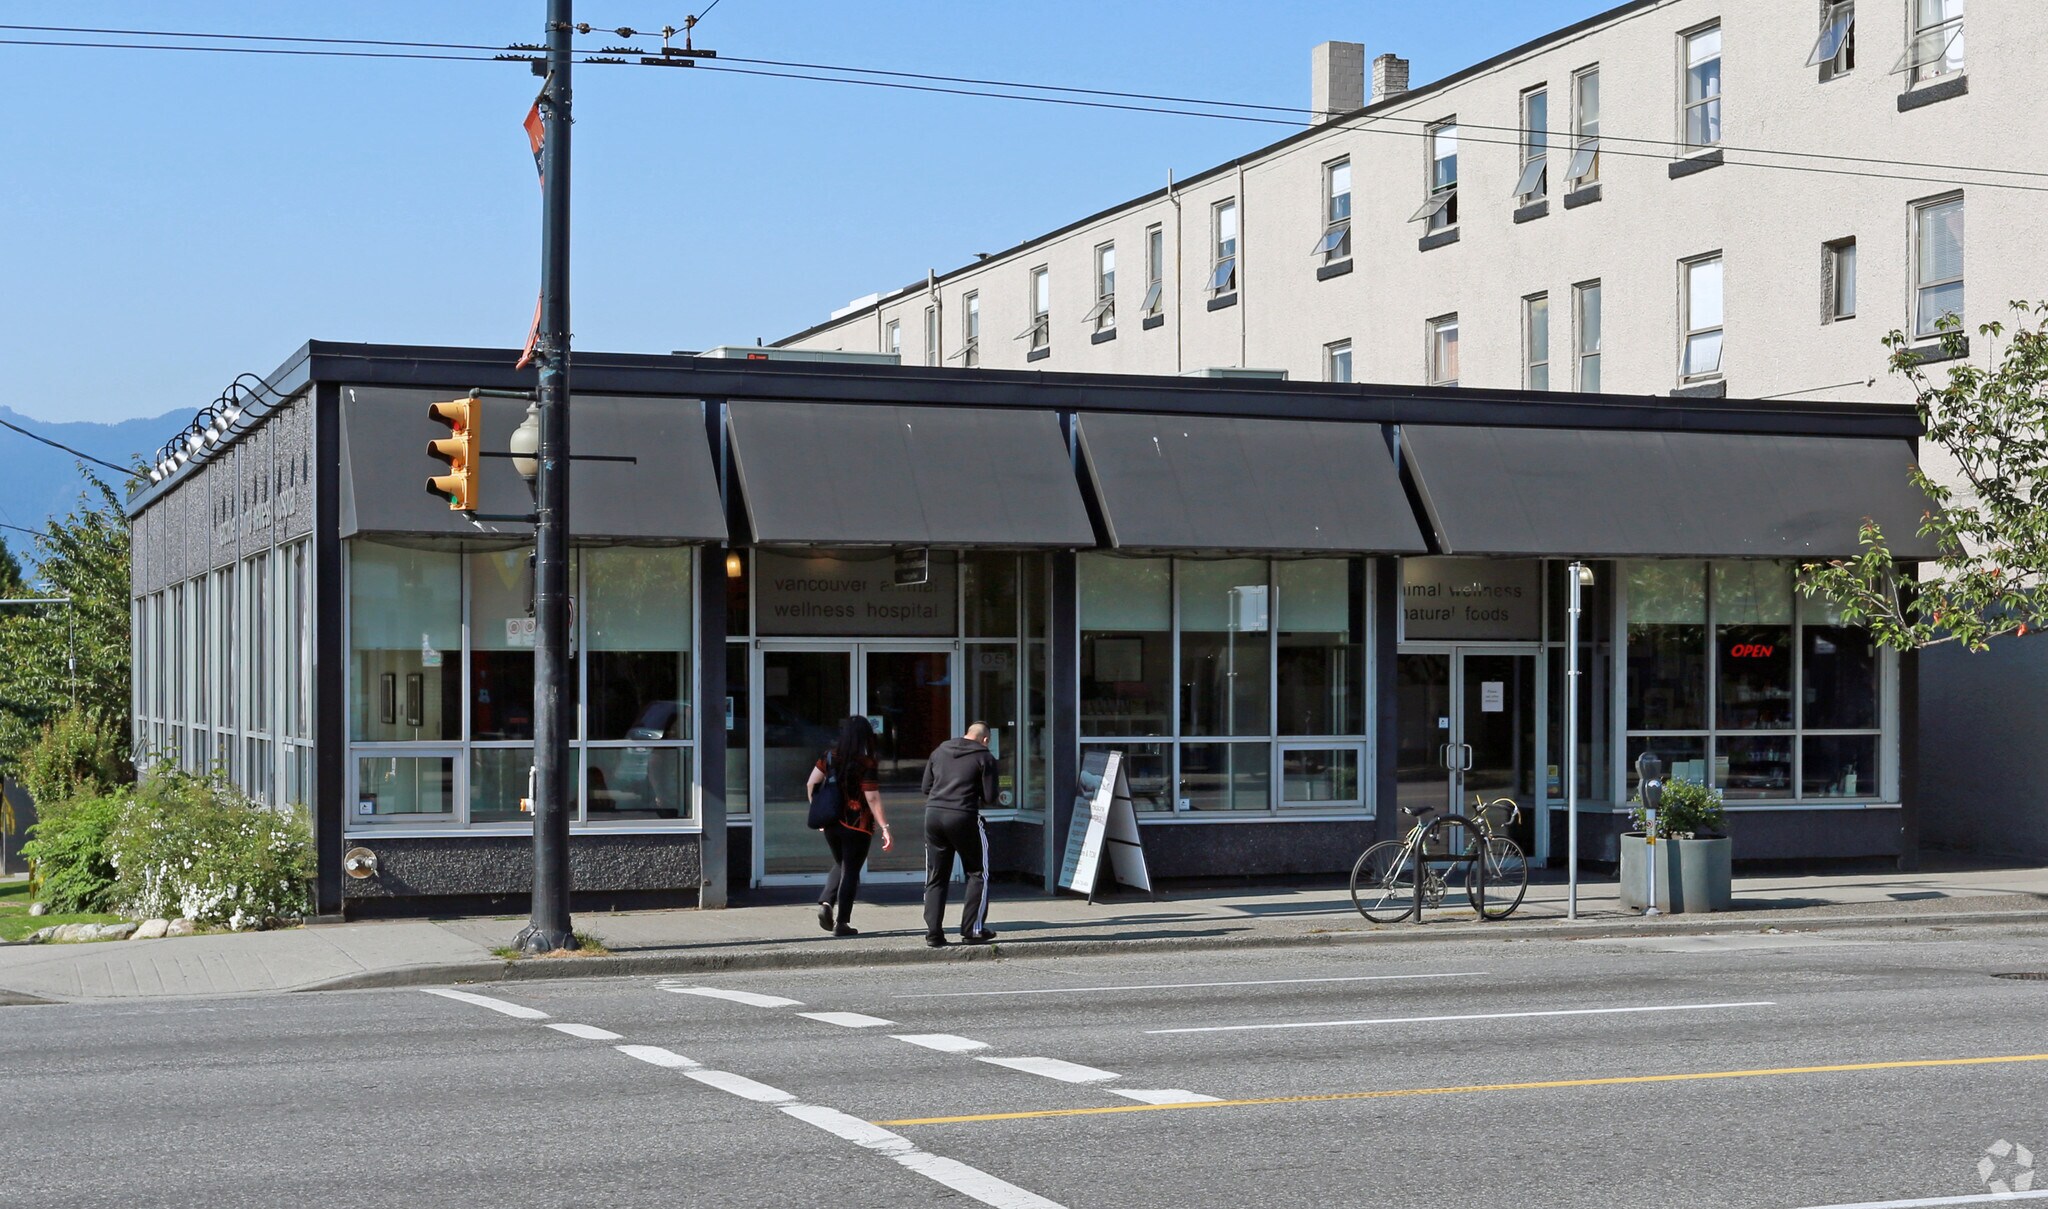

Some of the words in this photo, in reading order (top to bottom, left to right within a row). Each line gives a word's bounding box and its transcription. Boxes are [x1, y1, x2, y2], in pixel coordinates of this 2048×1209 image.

[774, 579, 867, 592] vancouver
[1403, 582, 1441, 597] imal
[1449, 582, 1522, 598] wellness
[774, 602, 855, 617] wellness
[867, 602, 938, 621] hospital
[1465, 606, 1509, 621] foods
[1731, 644, 1774, 657] OPEN
